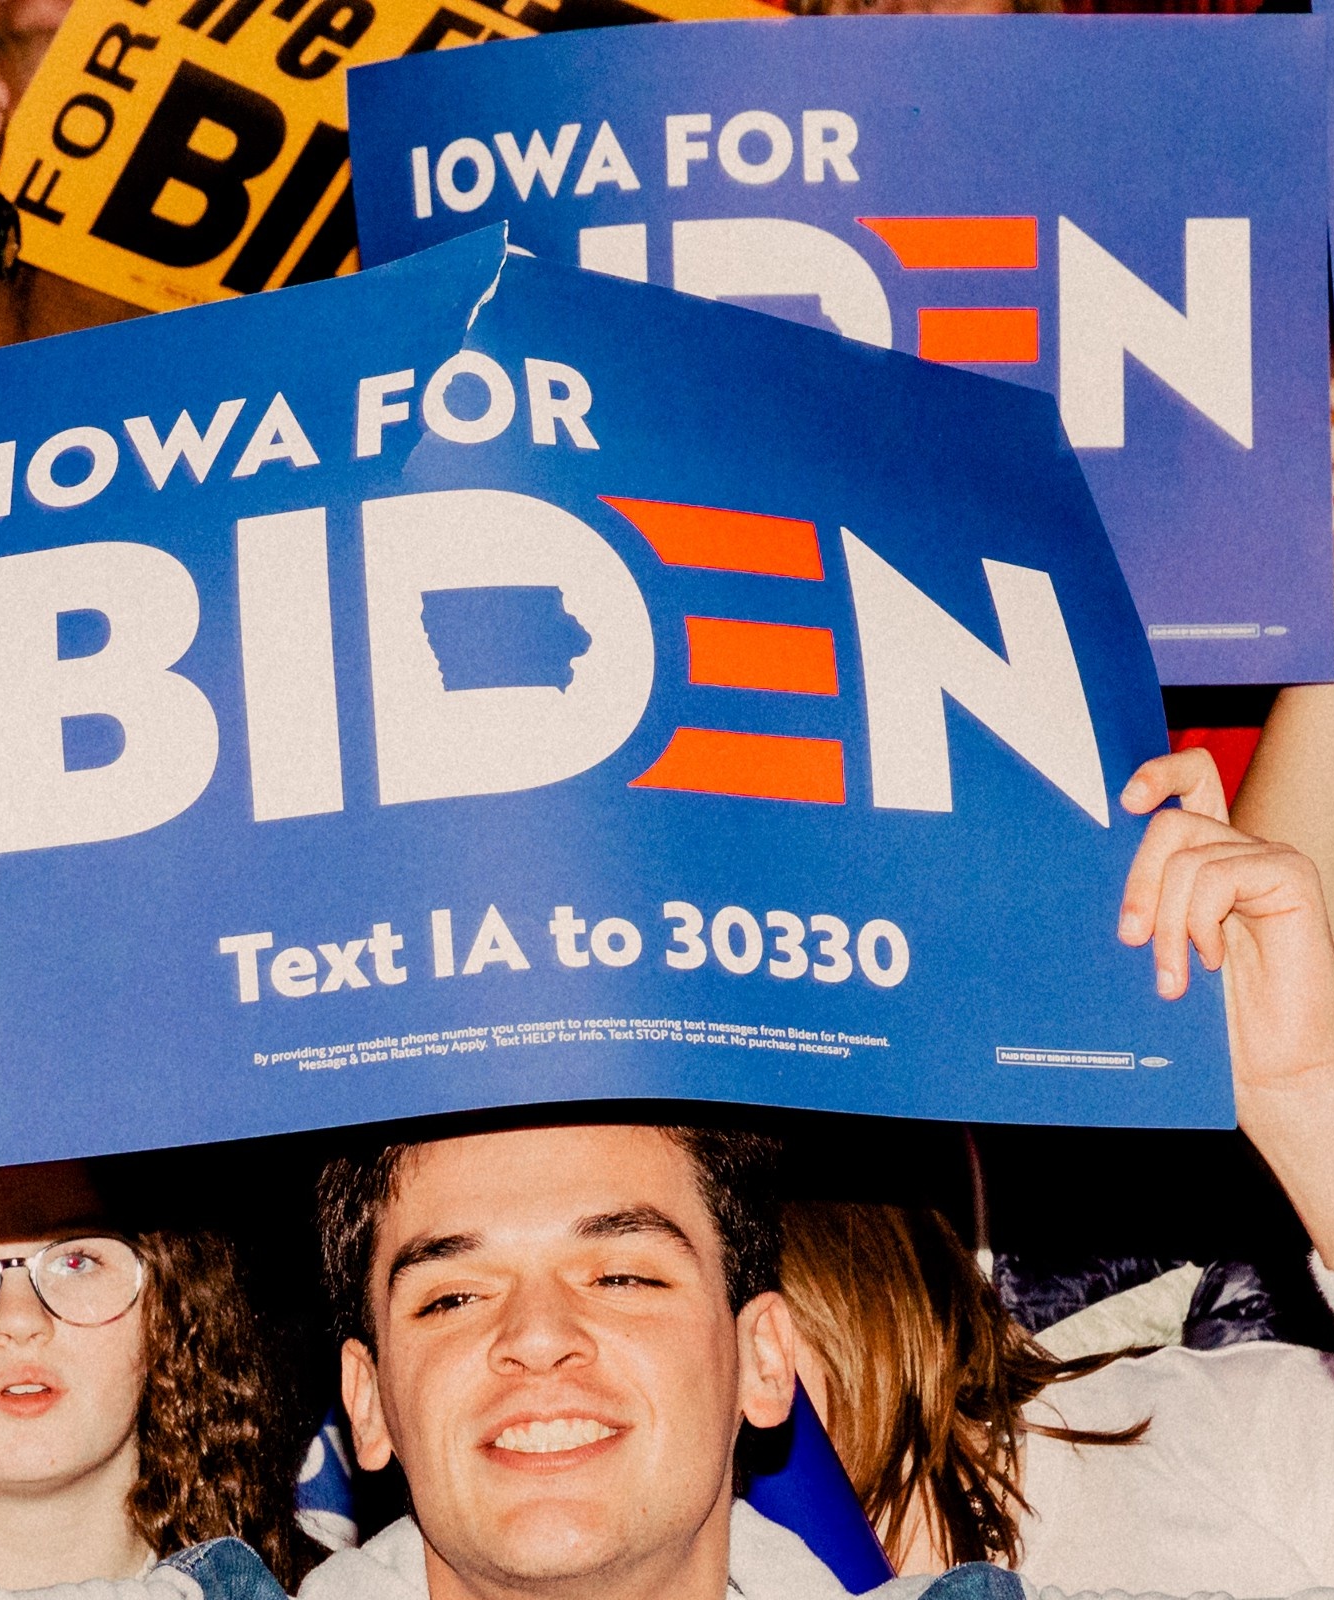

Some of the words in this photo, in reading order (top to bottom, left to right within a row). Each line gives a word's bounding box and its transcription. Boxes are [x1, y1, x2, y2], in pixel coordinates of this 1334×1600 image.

[15, 21, 160, 226] FOR
[410, 119, 641, 219] IOWA
[667, 109, 860, 188] FOR
[356, 350, 600, 458] FOR
[219, 919, 409, 1004] Text
[428, 903, 533, 981] IA
[548, 902, 644, 970] to
[662, 899, 912, 988] 30330
[254, 1051, 268, 1066] By
[272, 1045, 326, 1066] providing
[329, 1044, 354, 1059] your
[358, 1034, 398, 1050] mobile
[401, 1031, 438, 1048] phone
[442, 1025, 489, 1040] number
[492, 1024, 513, 1038] you
[517, 1018, 565, 1032] consent
[568, 1018, 580, 1029] to
[584, 1015, 626, 1028] receive
[630, 1015, 681, 1031] recurring
[684, 1019, 706, 1030] text
[708, 1021, 758, 1036] messages
[760, 1022, 786, 1037] from
[788, 1025, 818, 1040] Biden
[820, 1028, 835, 1042] for
[838, 1029, 890, 1047] President.
[299, 1057, 347, 1070] Message
[361, 1049, 388, 1062] Data
[391, 1047, 423, 1060] Rates
[425, 1041, 449, 1055] May
[452, 1037, 488, 1054] Apply.
[494, 1034, 520, 1046] Text
[523, 1029, 556, 1044] HELP
[559, 1028, 576, 1041] for
[579, 1028, 606, 1041] Info.
[608, 1027, 634, 1040] Text
[636, 1027, 668, 1040] STOP
[670, 1030, 683, 1041] to
[686, 1032, 705, 1045] opt
[731, 1032, 746, 1046] No
[749, 1036, 796, 1051] purchase
[799, 1042, 851, 1058] necessary.
